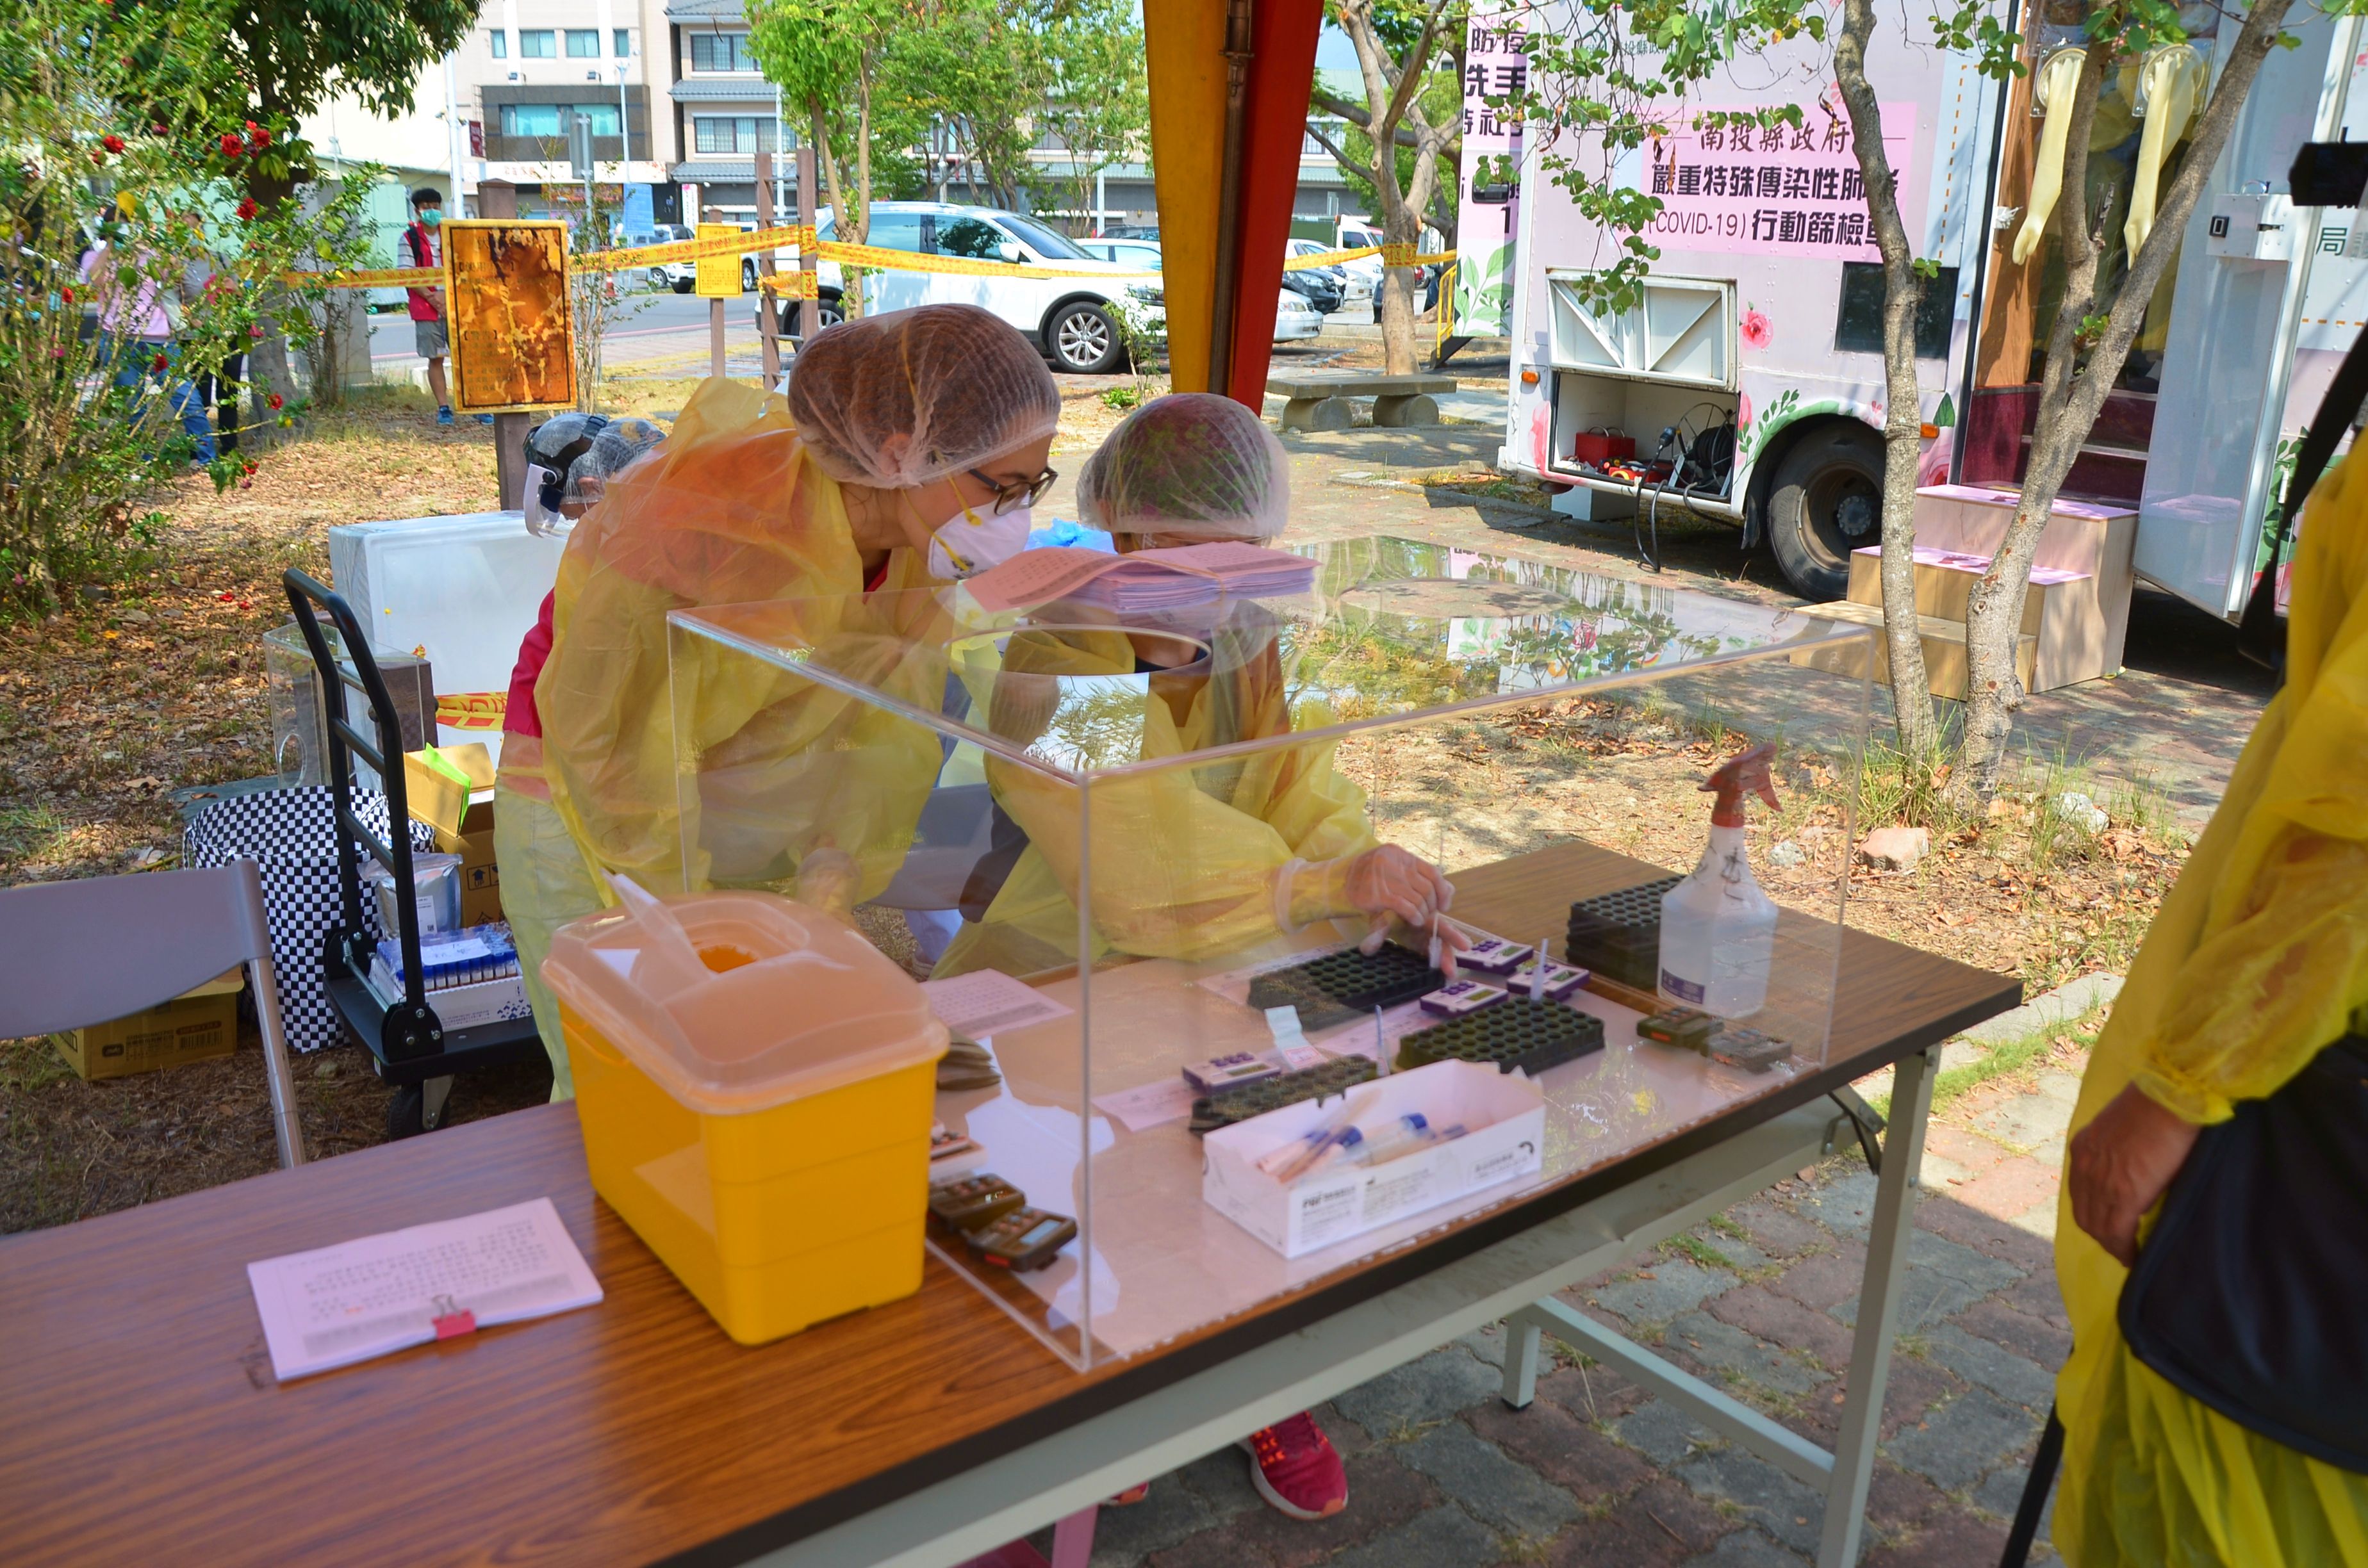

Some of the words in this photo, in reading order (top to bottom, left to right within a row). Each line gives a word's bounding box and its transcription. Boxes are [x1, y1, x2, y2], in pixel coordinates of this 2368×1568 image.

[1701, 120, 1850, 154] 南投縣政府
[1651, 165, 1900, 201] 嚴重特殊傳染性肺
